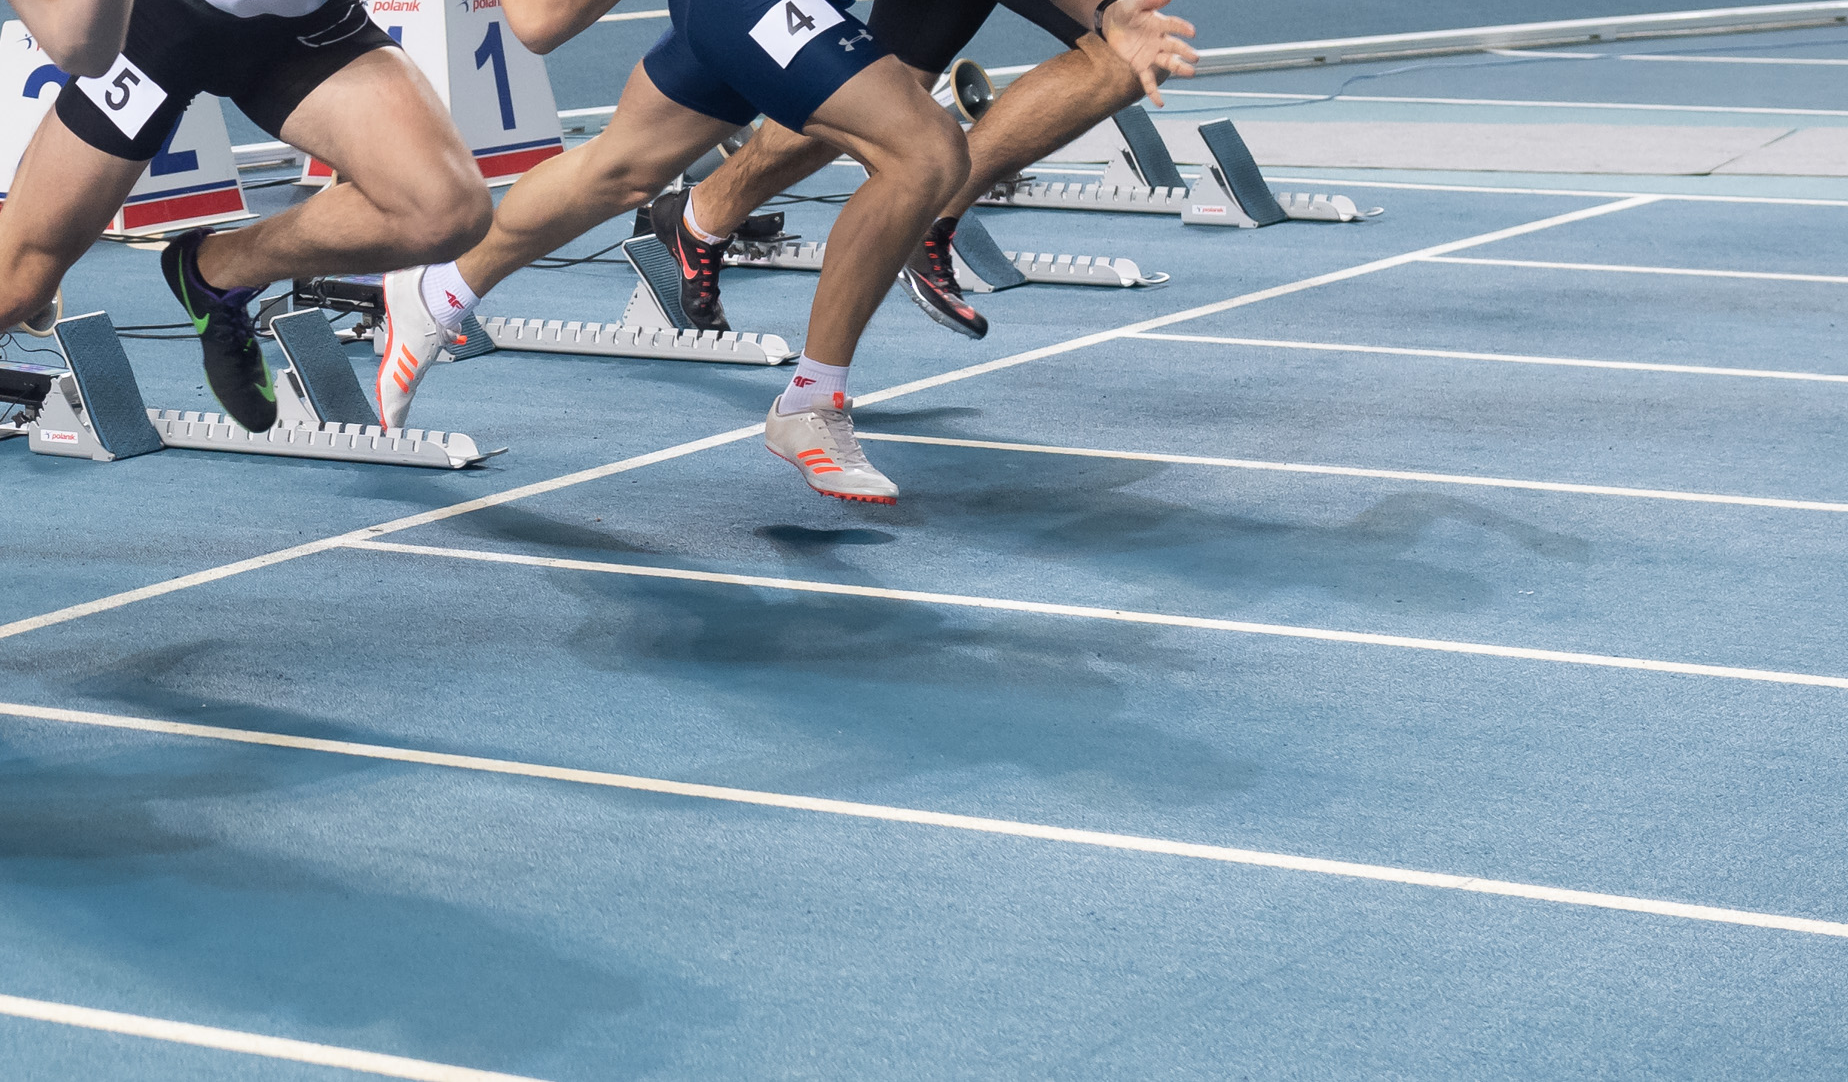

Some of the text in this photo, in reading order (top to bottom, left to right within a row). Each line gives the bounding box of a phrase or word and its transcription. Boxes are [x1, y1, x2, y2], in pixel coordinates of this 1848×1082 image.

[373, 0, 421, 14] polanik
[785, 0, 816, 36] 4
[105, 67, 141, 111] 5
[474, 21, 517, 131] 1
